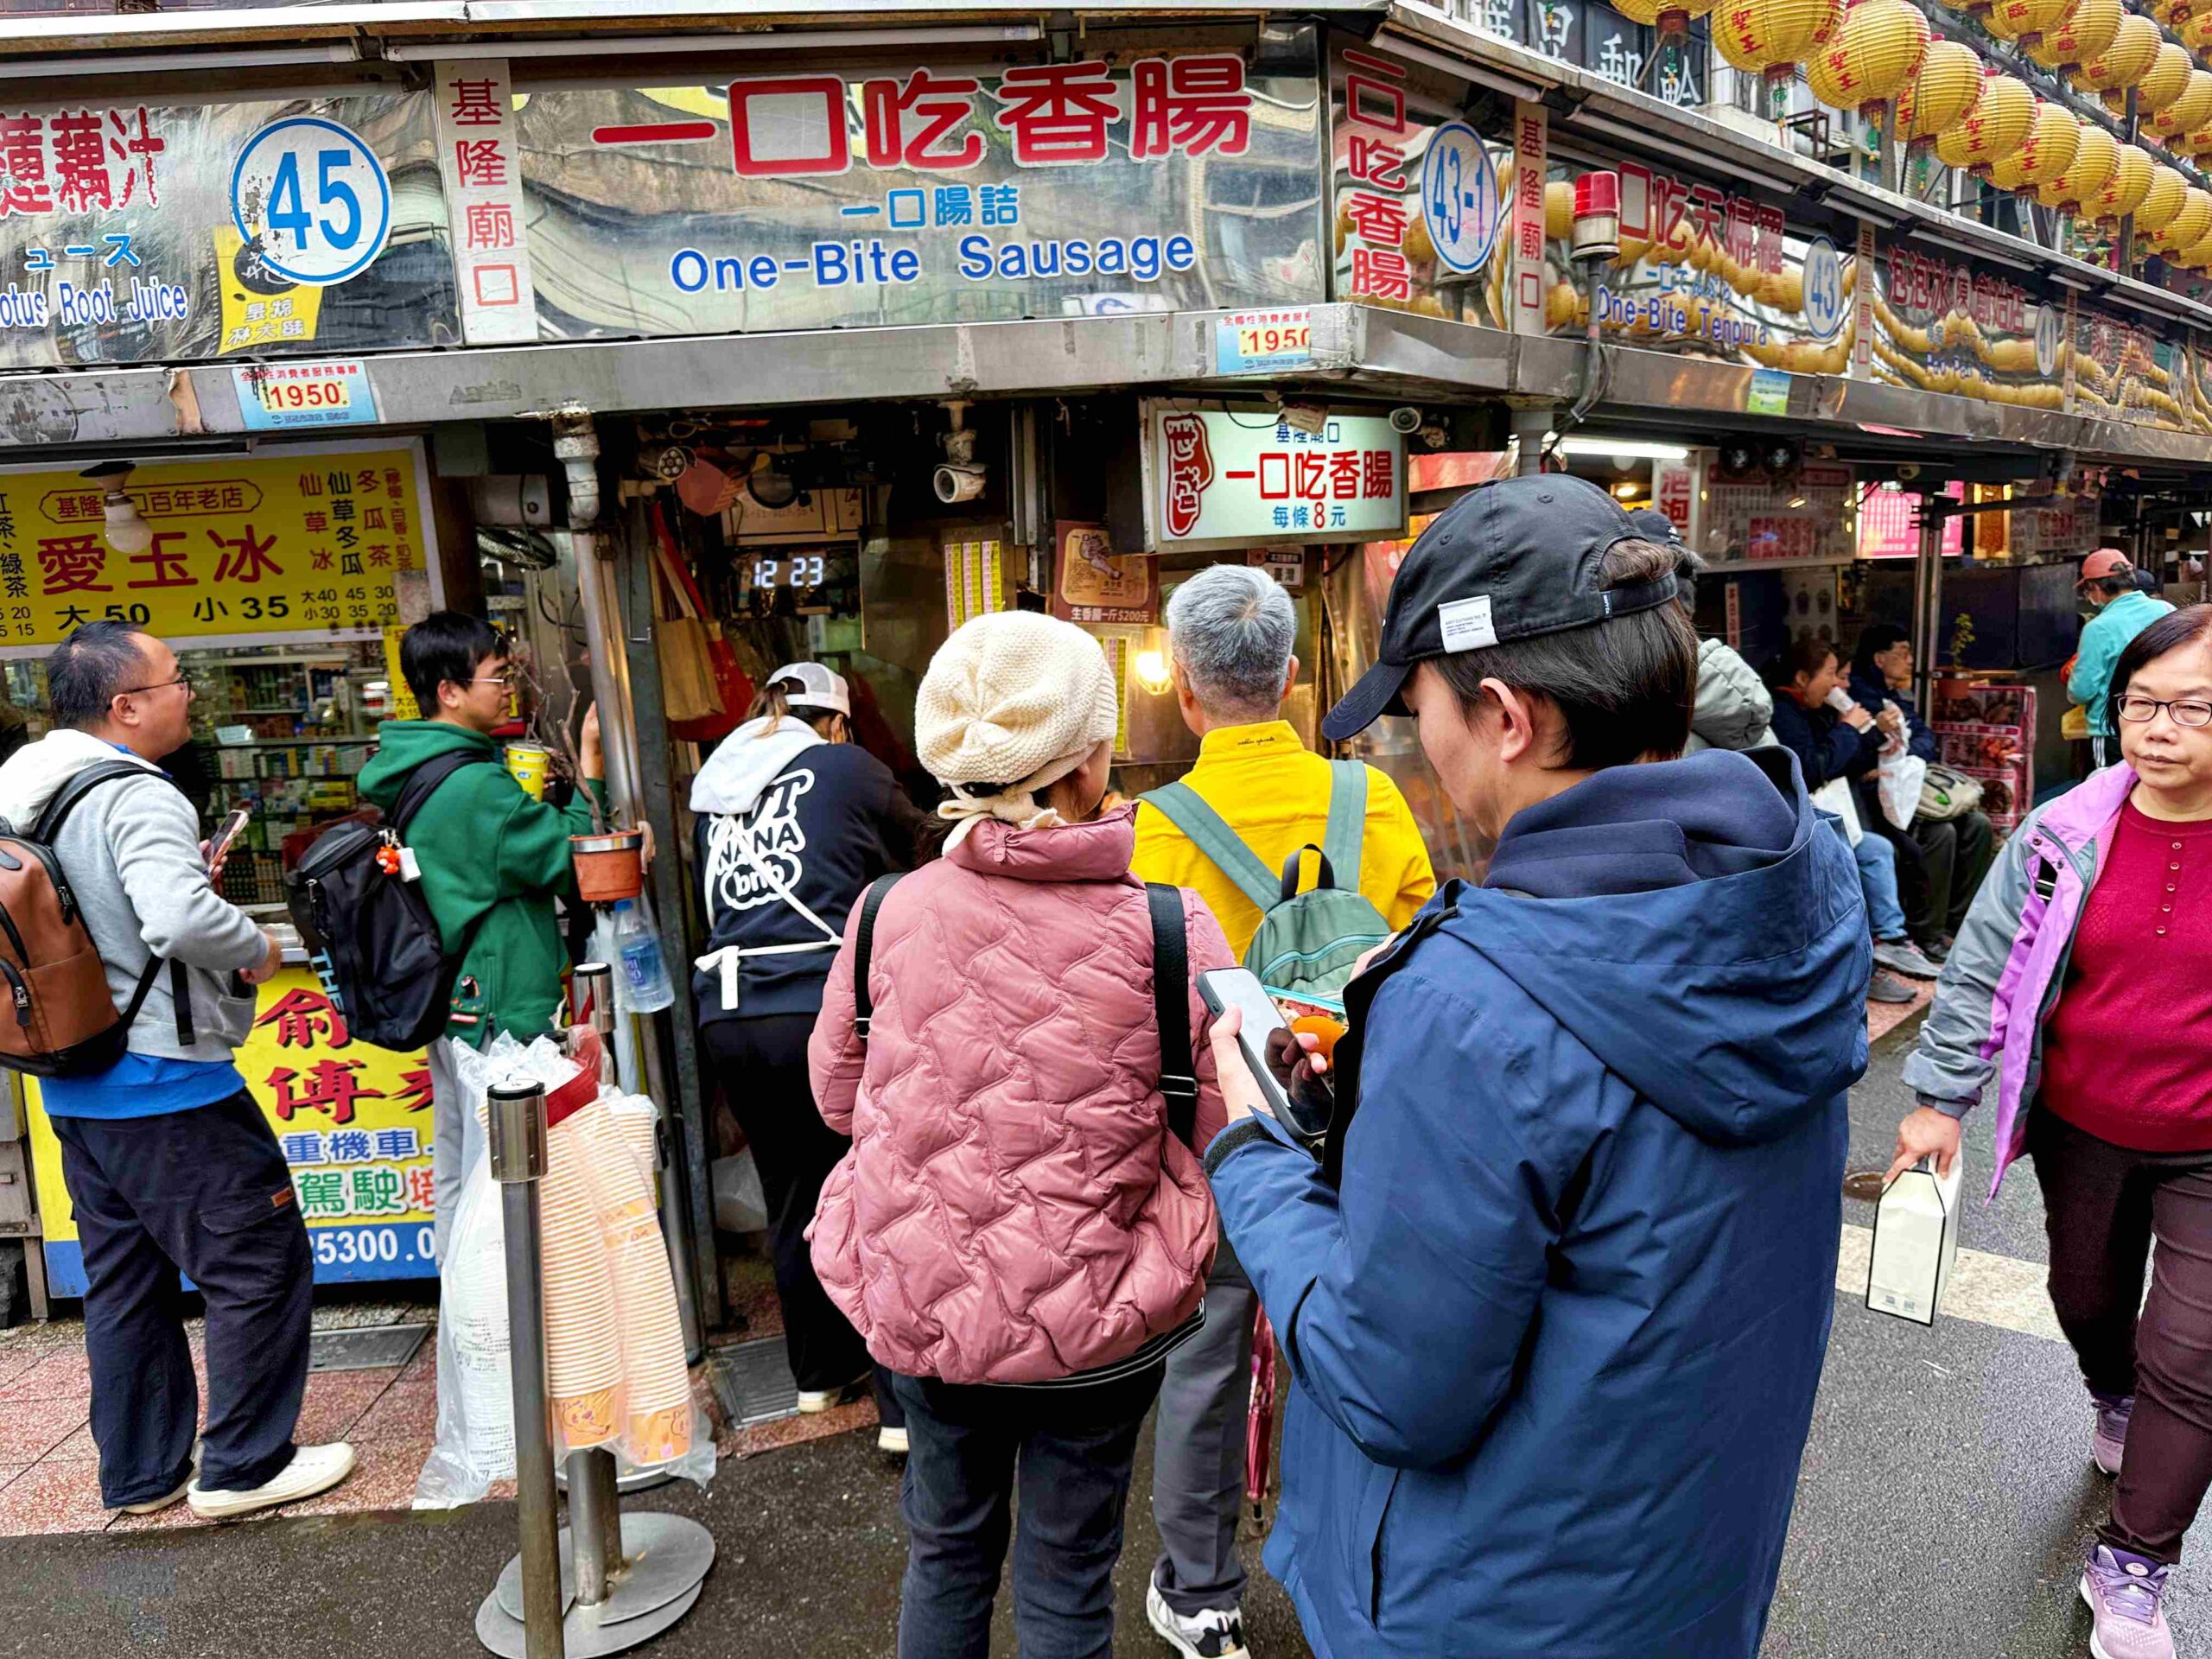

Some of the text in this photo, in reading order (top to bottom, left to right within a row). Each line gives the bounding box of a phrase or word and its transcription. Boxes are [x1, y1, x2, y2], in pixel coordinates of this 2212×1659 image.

[591, 57, 1252, 175] 一口吃香腸
[267, 149, 361, 251] 45
[448, 78, 518, 307] 基隆廟口
[1343, 49, 1411, 301] 一口吃香腸
[1433, 145, 1484, 249] 43-1
[842, 185, 1020, 228] 一口腸詰
[1521, 116, 1542, 308] 基隆廟口
[27, 235, 140, 269] ュース
[672, 236, 1194, 290] One-Bite Sausage
[59, 281, 115, 324] Root
[130, 278, 187, 319] Juice
[1599, 286, 1685, 334] One-Bite
[1811, 255, 1835, 320] 43
[270, 383, 341, 408] 1950
[1225, 450, 1394, 499] 一口吃香腸
[56, 486, 244, 518] 基隆口百年老店
[299, 473, 335, 570] 仙草冰
[327, 471, 365, 576] 仙草冬瓜
[357, 470, 392, 568] 冬瓜茶
[37, 524, 284, 595] 愛玉冰
[10, 606, 31, 620] 20
[55, 604, 91, 630] 大
[194, 596, 229, 621] 小
[240, 595, 289, 620] 35
[346, 587, 366, 601] 45
[373, 585, 395, 600] 30
[348, 604, 369, 618] 35
[15, 623, 35, 637] 15
